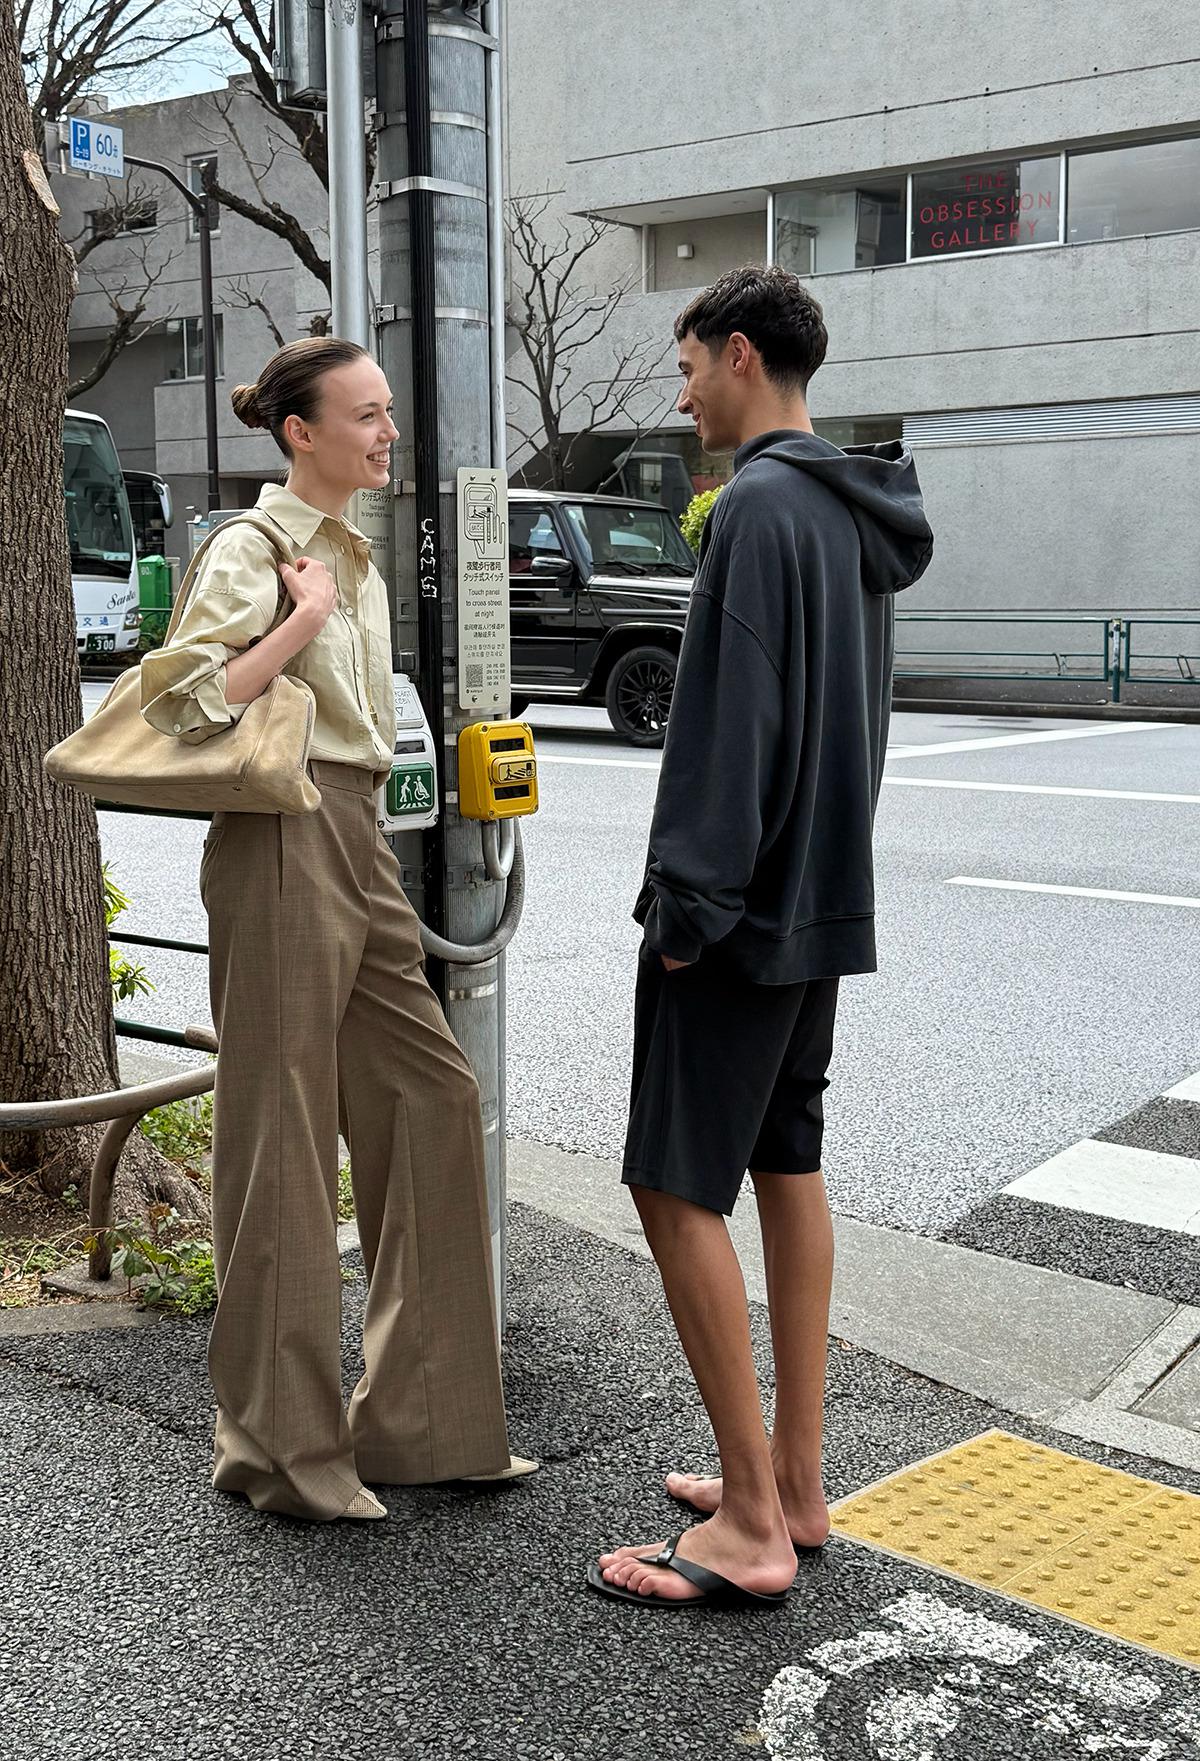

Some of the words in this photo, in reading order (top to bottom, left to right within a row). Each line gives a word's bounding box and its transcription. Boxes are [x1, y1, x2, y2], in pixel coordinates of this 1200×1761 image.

[77, 124, 88, 146] P
[961, 172, 1009, 193] THE
[919, 191, 1052, 224] OBSESSION
[931, 219, 1039, 249] GALLERY
[463, 572, 504, 582] タッチ式スイッチ
[485, 589, 500, 597] panel
[480, 610, 494, 618] night
